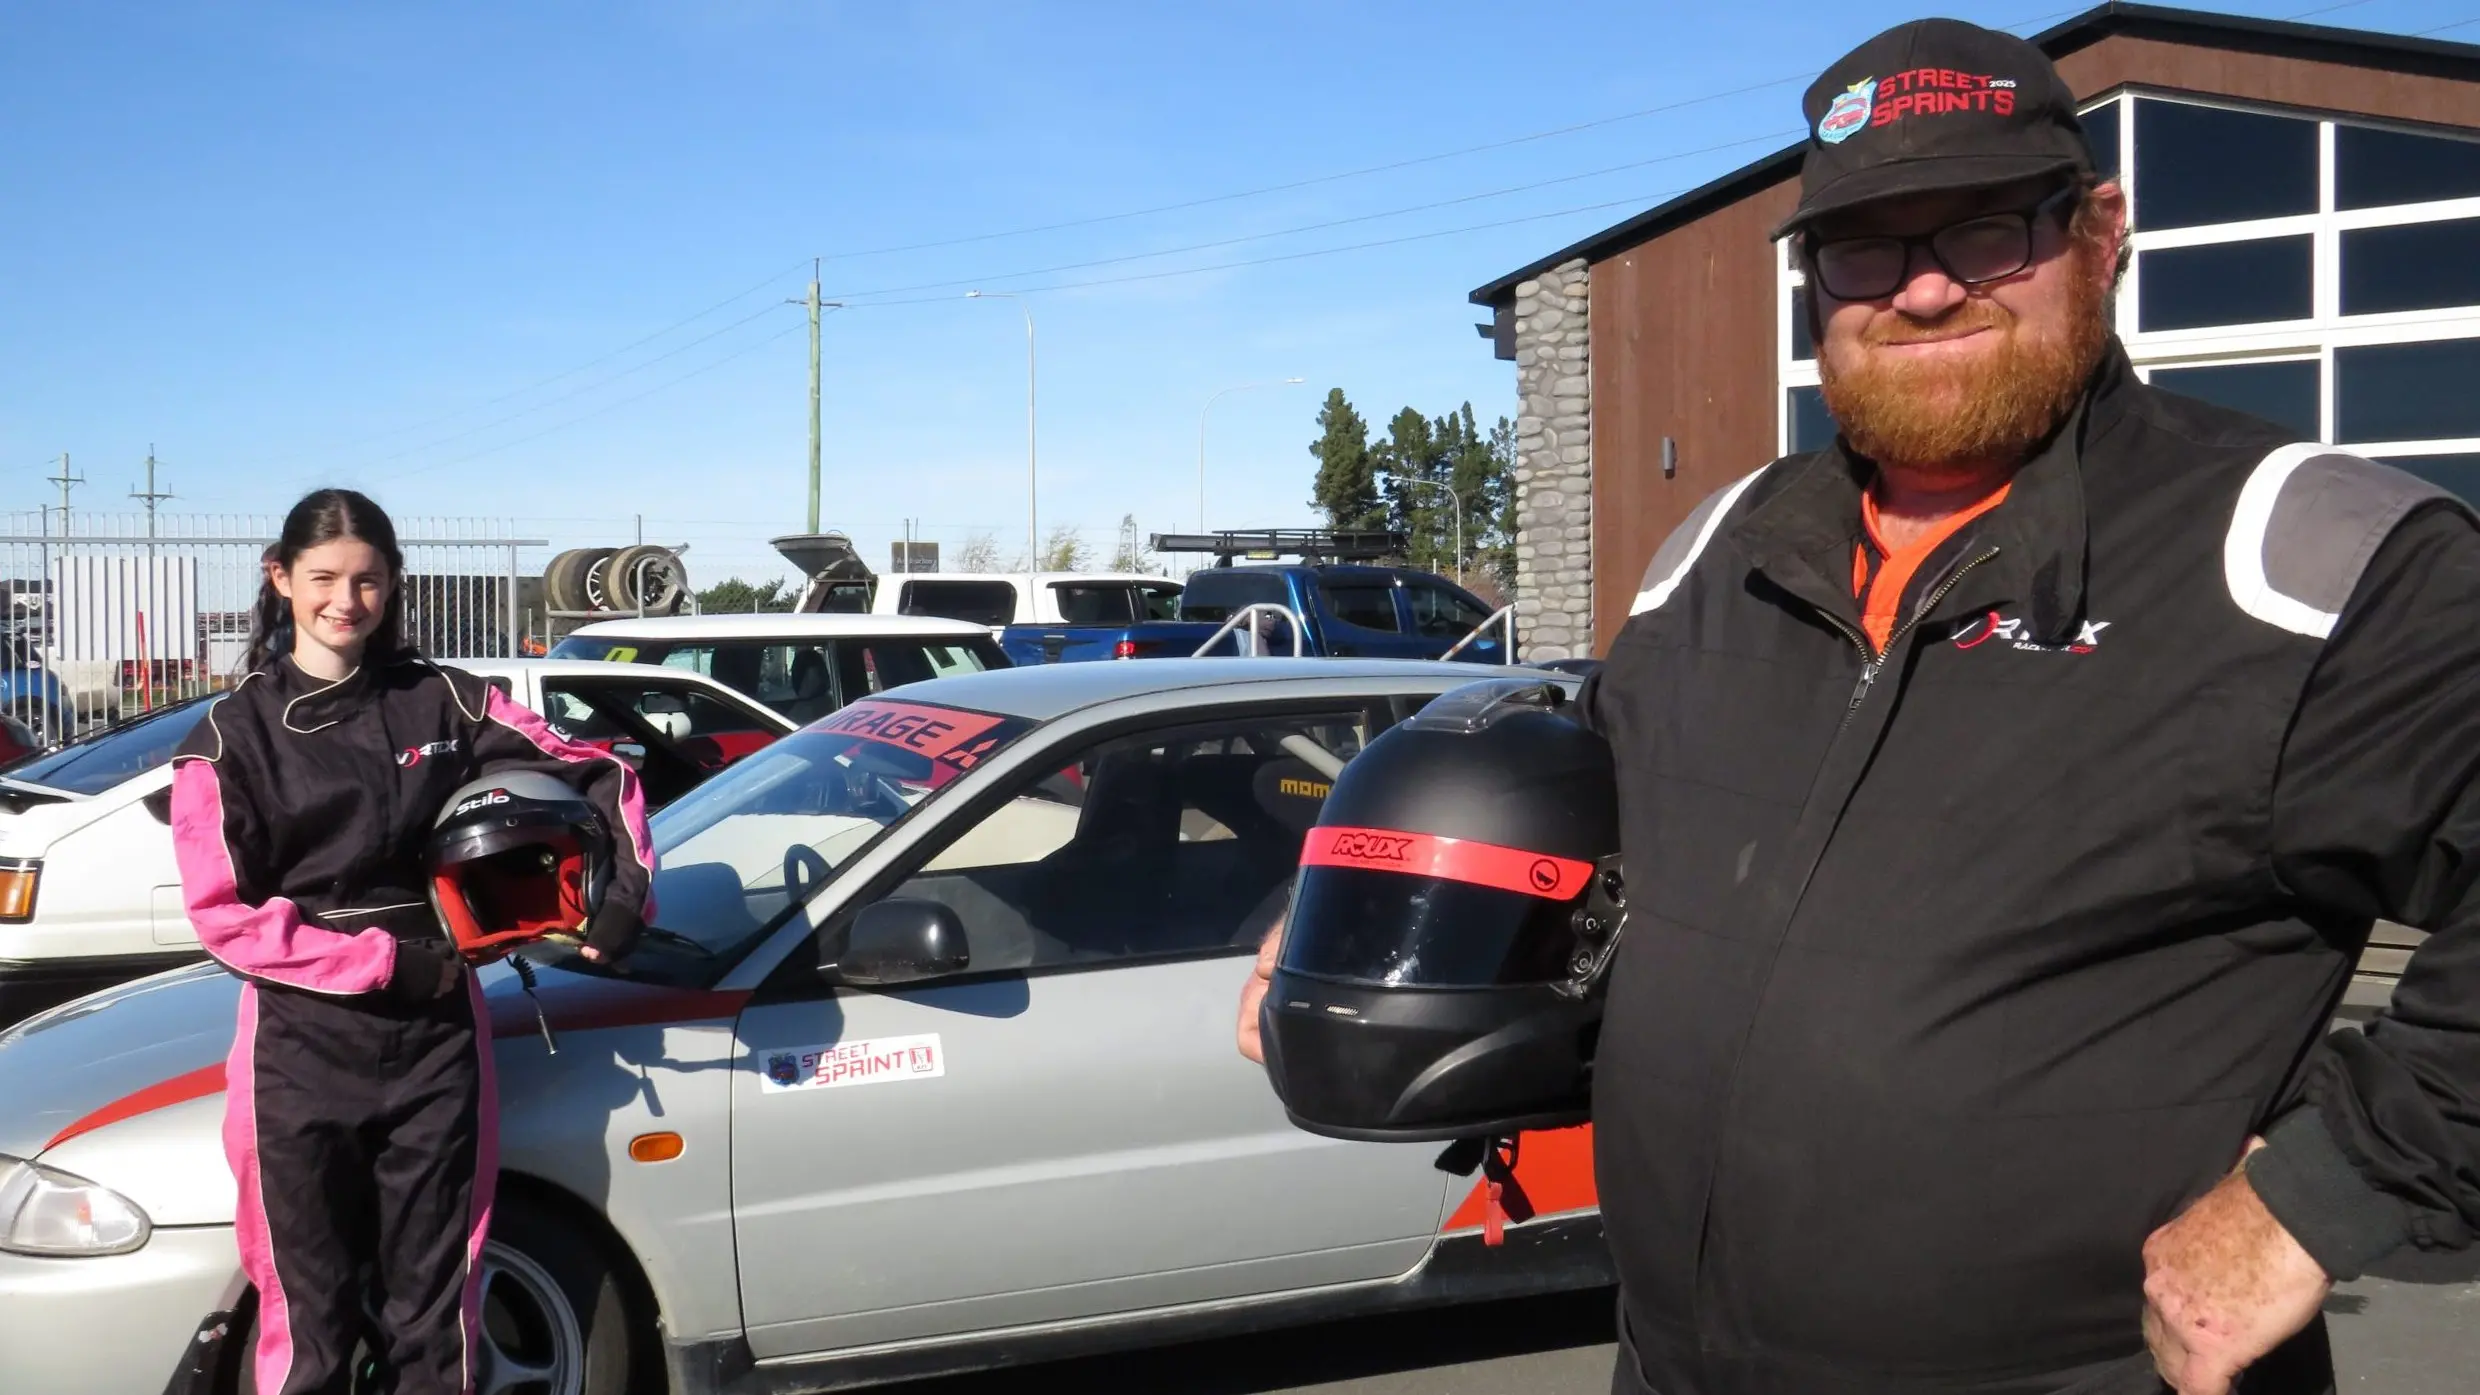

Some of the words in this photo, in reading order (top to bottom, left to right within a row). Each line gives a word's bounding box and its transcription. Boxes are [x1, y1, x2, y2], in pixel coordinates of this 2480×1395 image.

[1878, 68, 1993, 100] STREET
[1989, 79, 2017, 88] 2025
[1869, 90, 2015, 128] SPRINTS
[1280, 779, 1330, 798] mom
[456, 792, 510, 816] stilo
[1331, 833, 1414, 860] ROUX
[802, 1043, 870, 1068] STREET
[815, 1051, 905, 1086] SPRINT
